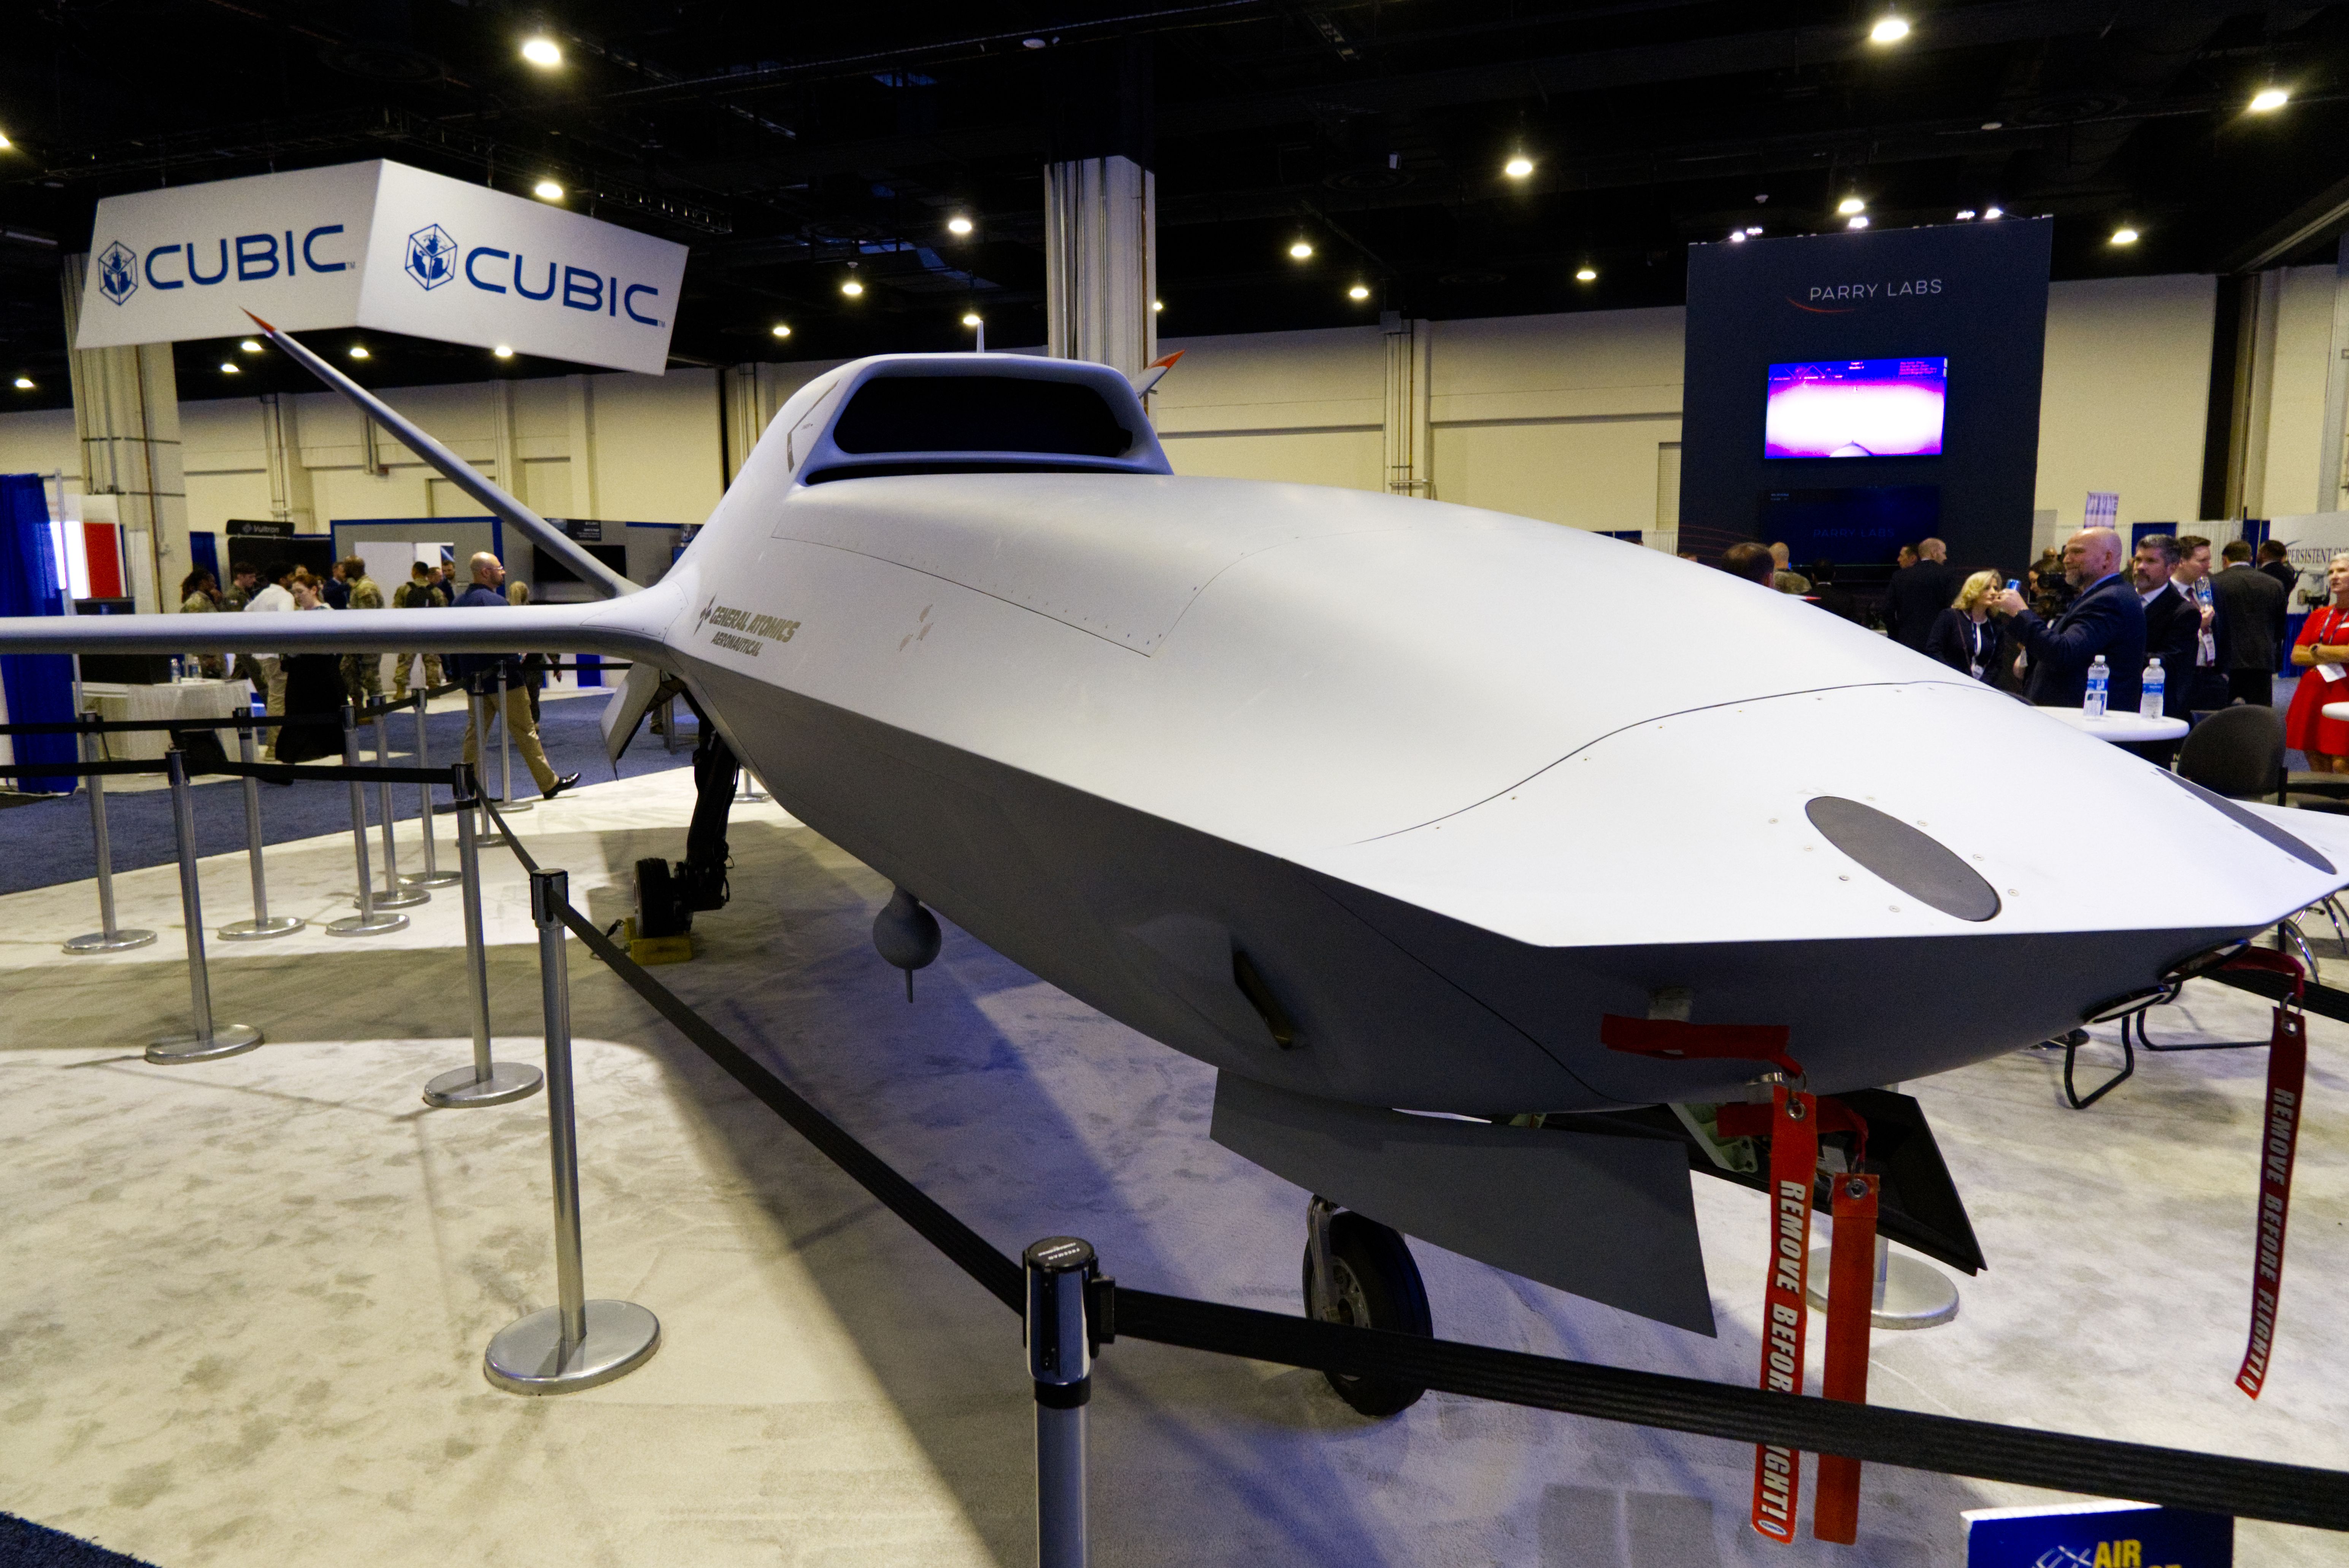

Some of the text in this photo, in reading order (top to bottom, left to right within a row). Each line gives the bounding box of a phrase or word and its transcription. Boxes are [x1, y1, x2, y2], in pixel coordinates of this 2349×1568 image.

[145, 224, 347, 290] CUBIC
[465, 246, 658, 326] CUBIC
[1810, 279, 1942, 301] PARRY LABS
[1813, 528, 1895, 538] PARRY LABS
[2287, 548, 2332, 564] PERSISTENT
[709, 606, 801, 643] GENERAL ATOMICS
[711, 631, 763, 657] AERONAUTICAL
[2266, 1087, 2296, 1186] REMOVE
[2259, 1193, 2283, 1283] BEFORE
[1761, 1180, 1806, 1521] REMOVE BEFOR IGHT!
[2092, 1539, 2142, 1568] AIR
